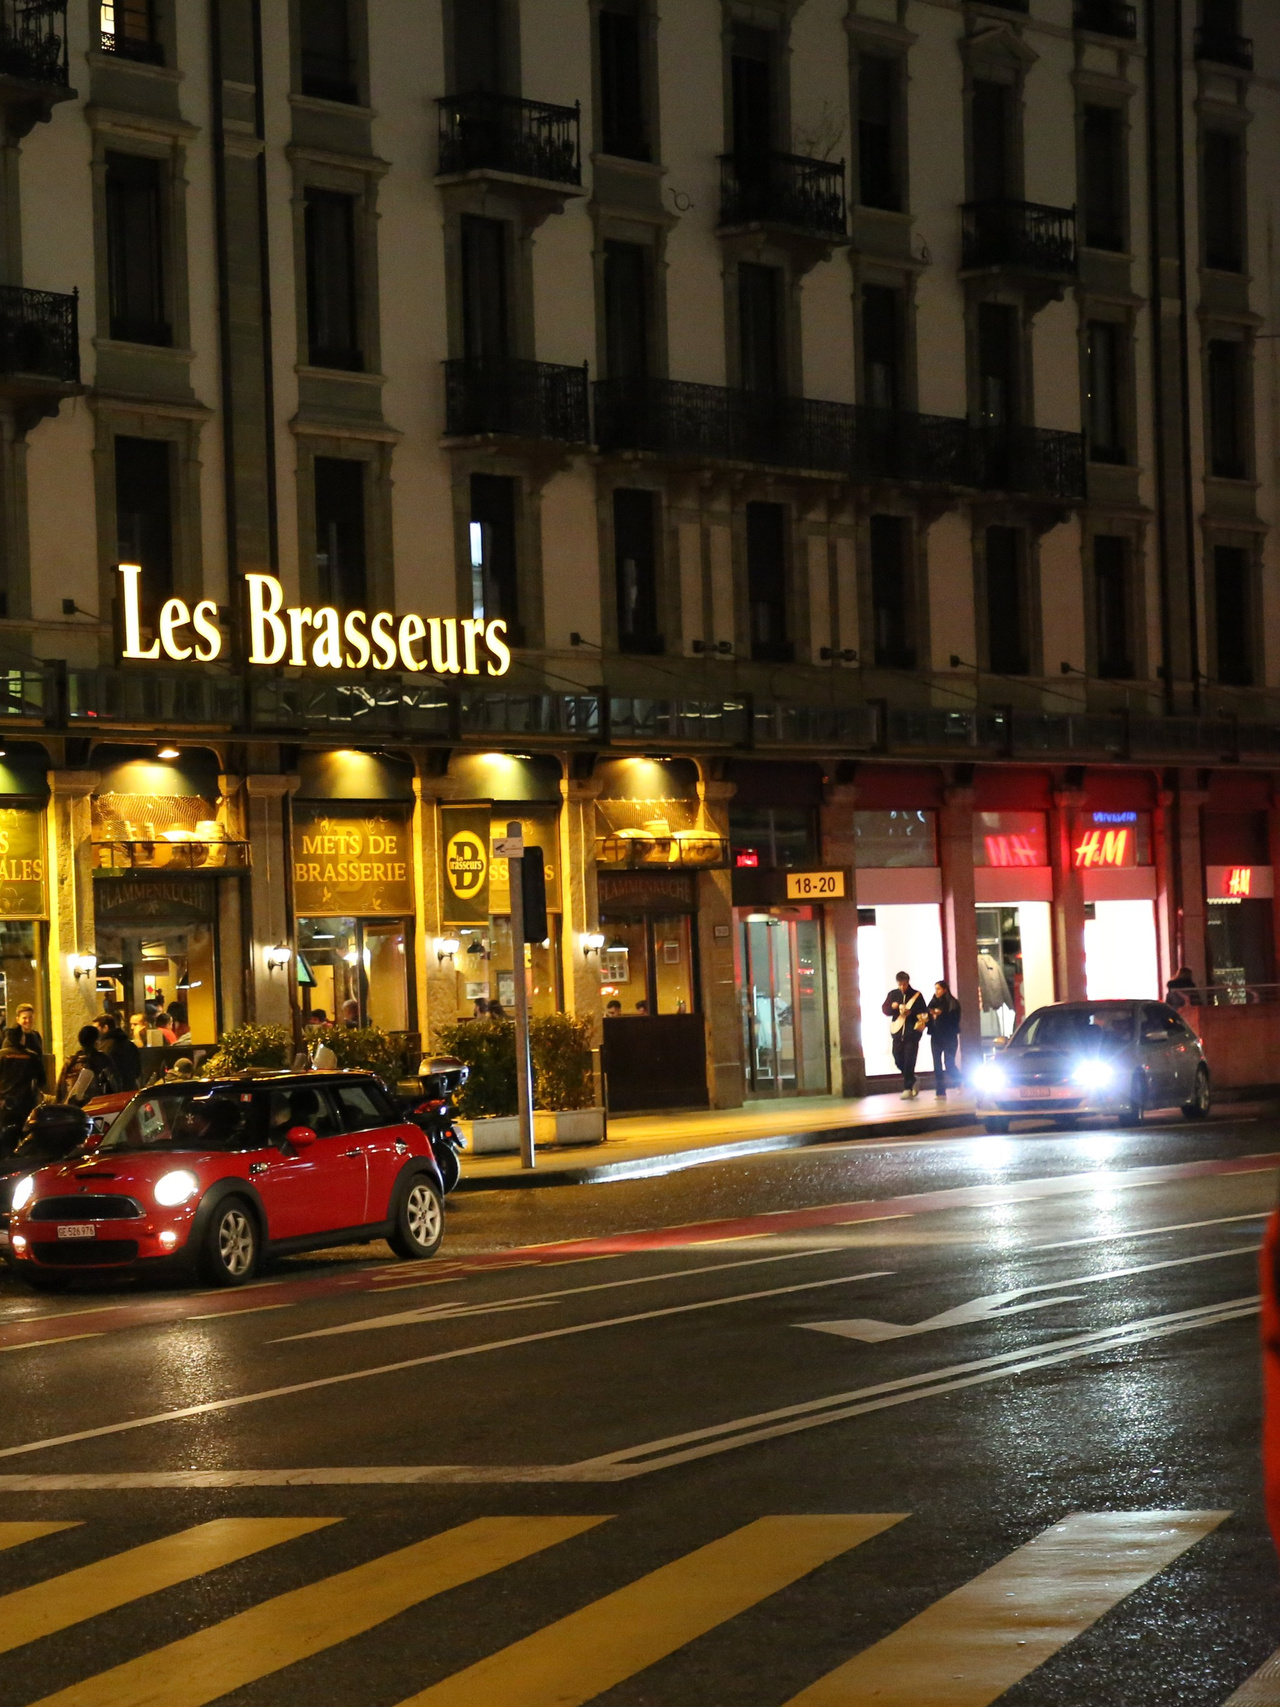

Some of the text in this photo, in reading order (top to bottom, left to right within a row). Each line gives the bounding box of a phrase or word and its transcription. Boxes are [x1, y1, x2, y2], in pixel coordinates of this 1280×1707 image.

[118, 564, 511, 676] Les Brasseurs
[302, 835, 398, 854] METS DE
[1075, 829, 1128, 868] H&M
[295, 862, 407, 882] BRASSERIE
[795, 876, 836, 894] 18-20
